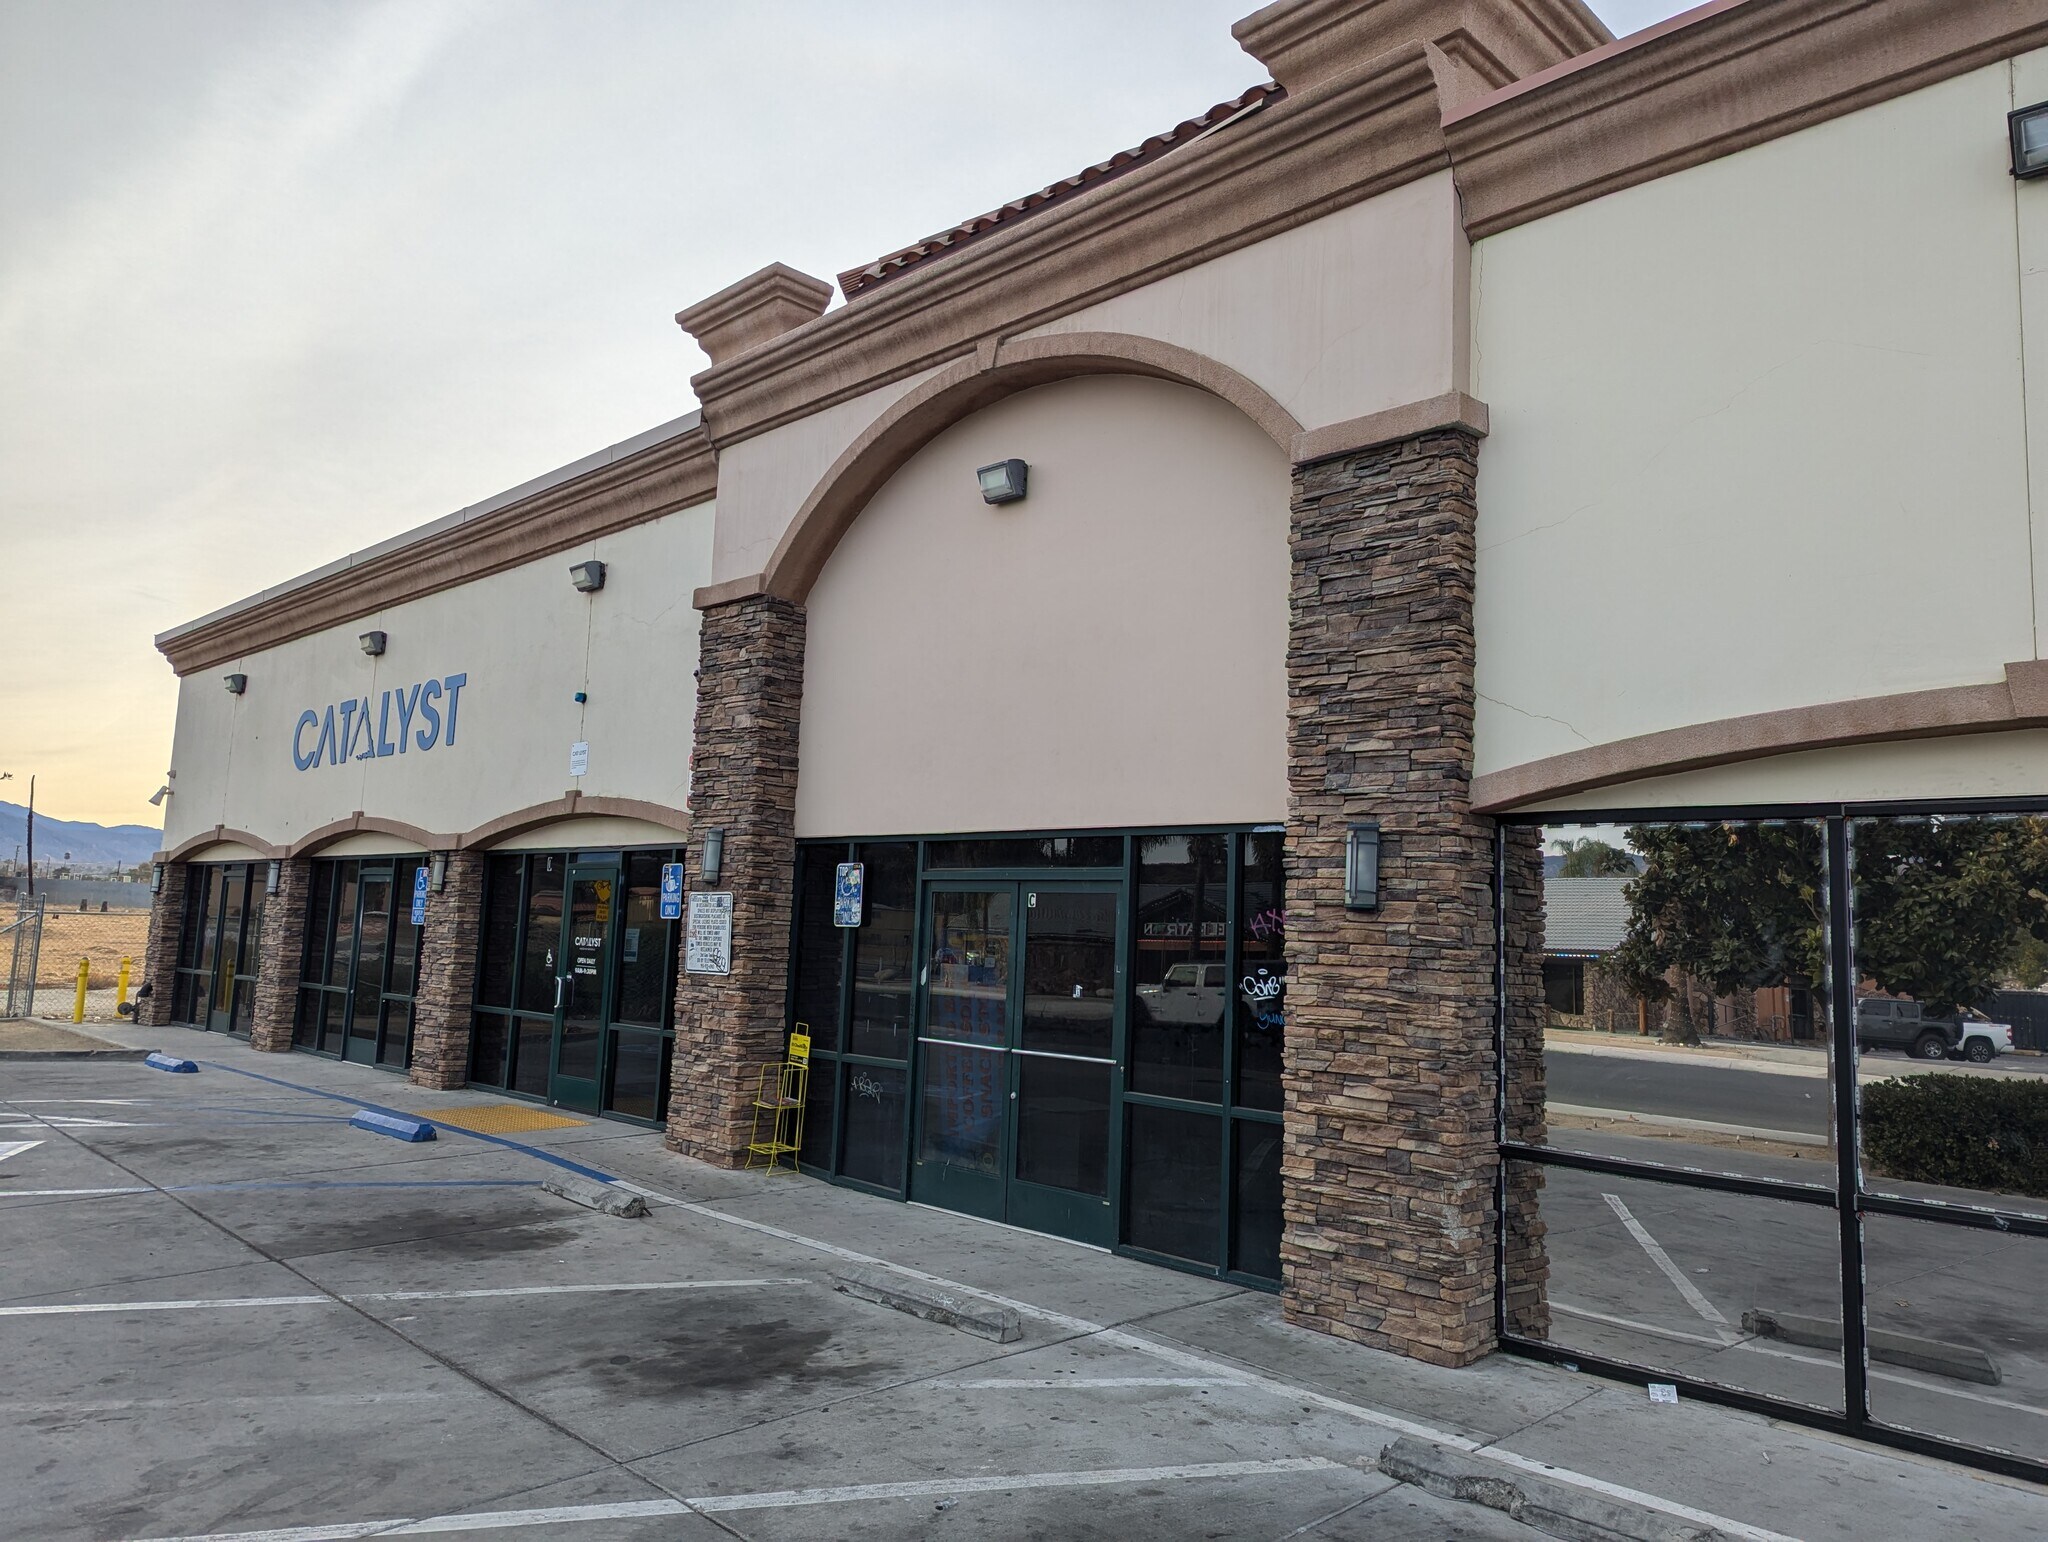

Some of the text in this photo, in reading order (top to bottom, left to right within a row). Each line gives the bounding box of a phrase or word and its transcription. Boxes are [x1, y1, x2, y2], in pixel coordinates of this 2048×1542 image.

[293, 673, 467, 771] CATALYST
[665, 905, 676, 916] ONLY
[575, 936, 601, 948] CATALYST
